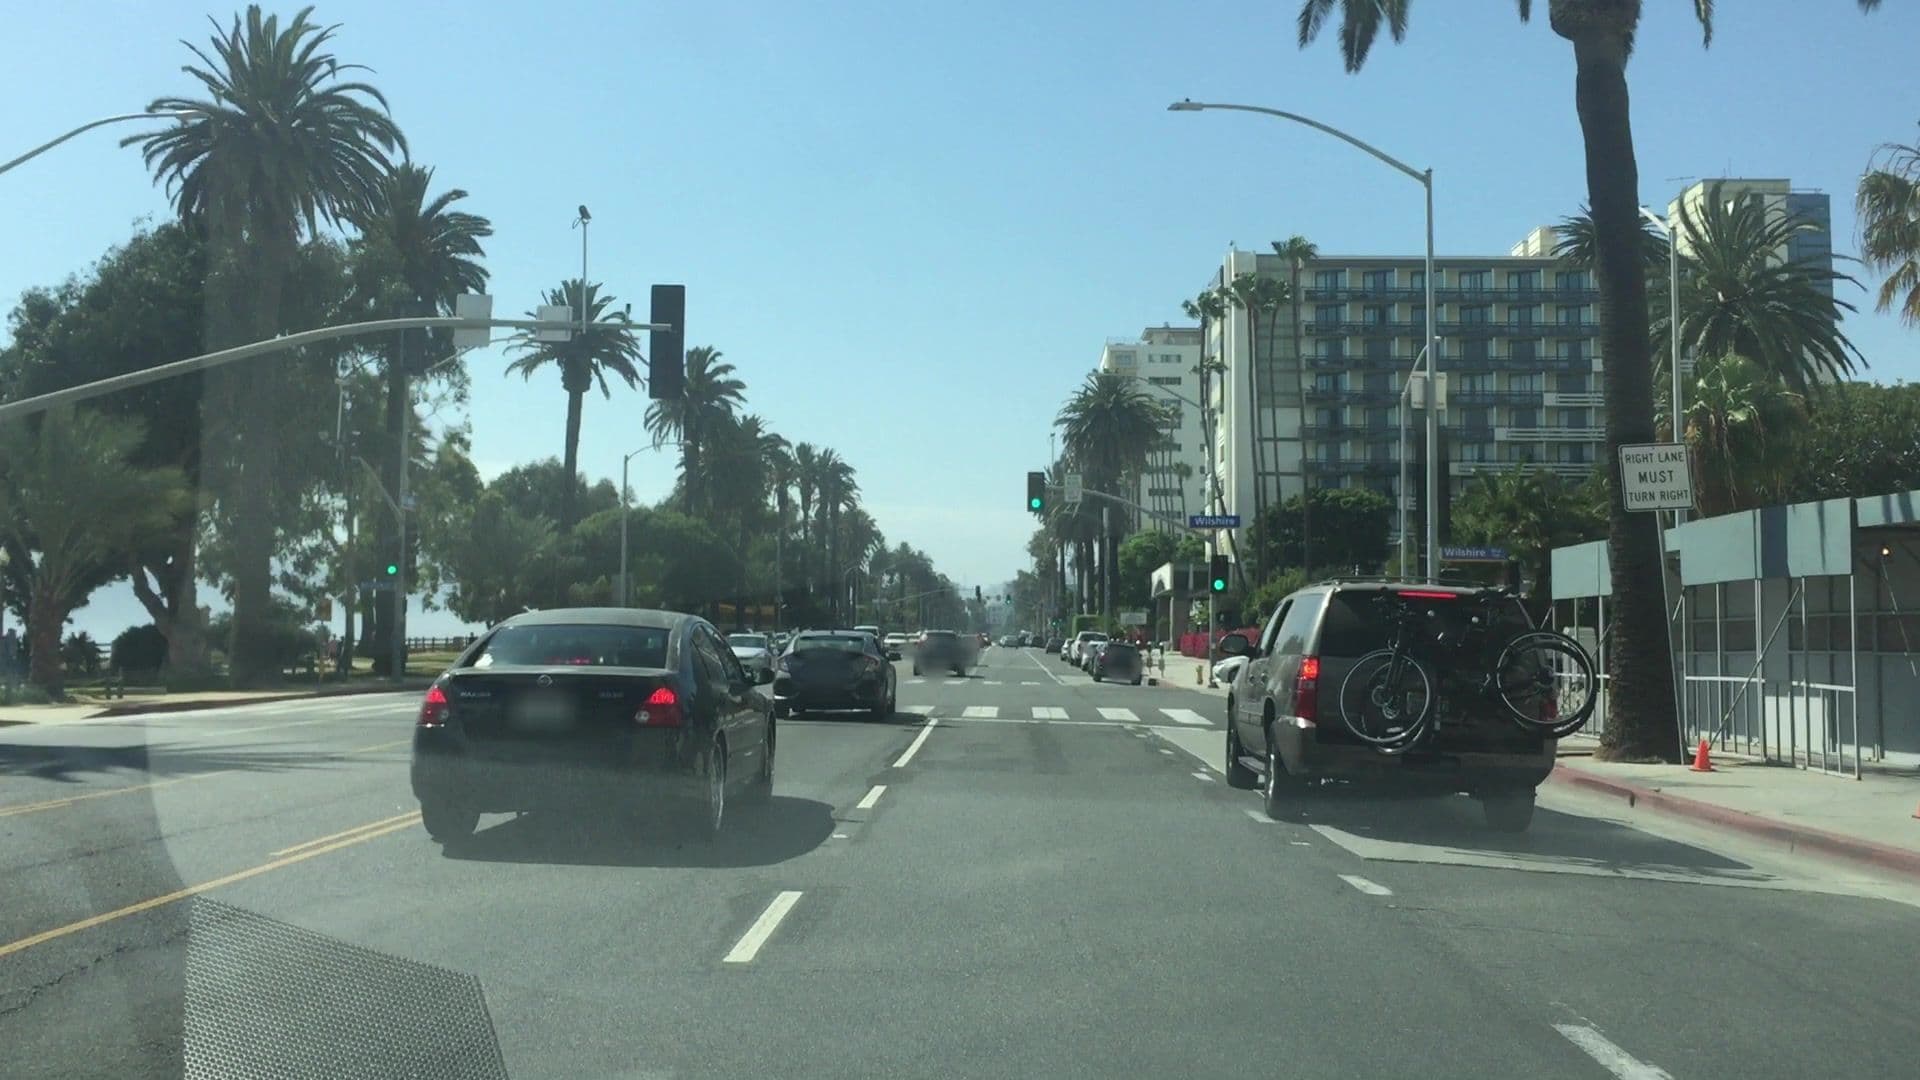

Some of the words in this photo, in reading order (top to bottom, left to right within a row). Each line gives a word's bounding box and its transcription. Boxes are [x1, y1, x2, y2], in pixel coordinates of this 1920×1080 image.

[1625, 453, 1654, 464] RIGHT
[1658, 451, 1684, 463] LANE
[1638, 470, 1674, 484] MUST
[1628, 490, 1655, 502] TURN
[1660, 489, 1689, 501] RIGHT
[1194, 516, 1236, 526] Wilshire
[1443, 547, 1486, 557] Wilshire
